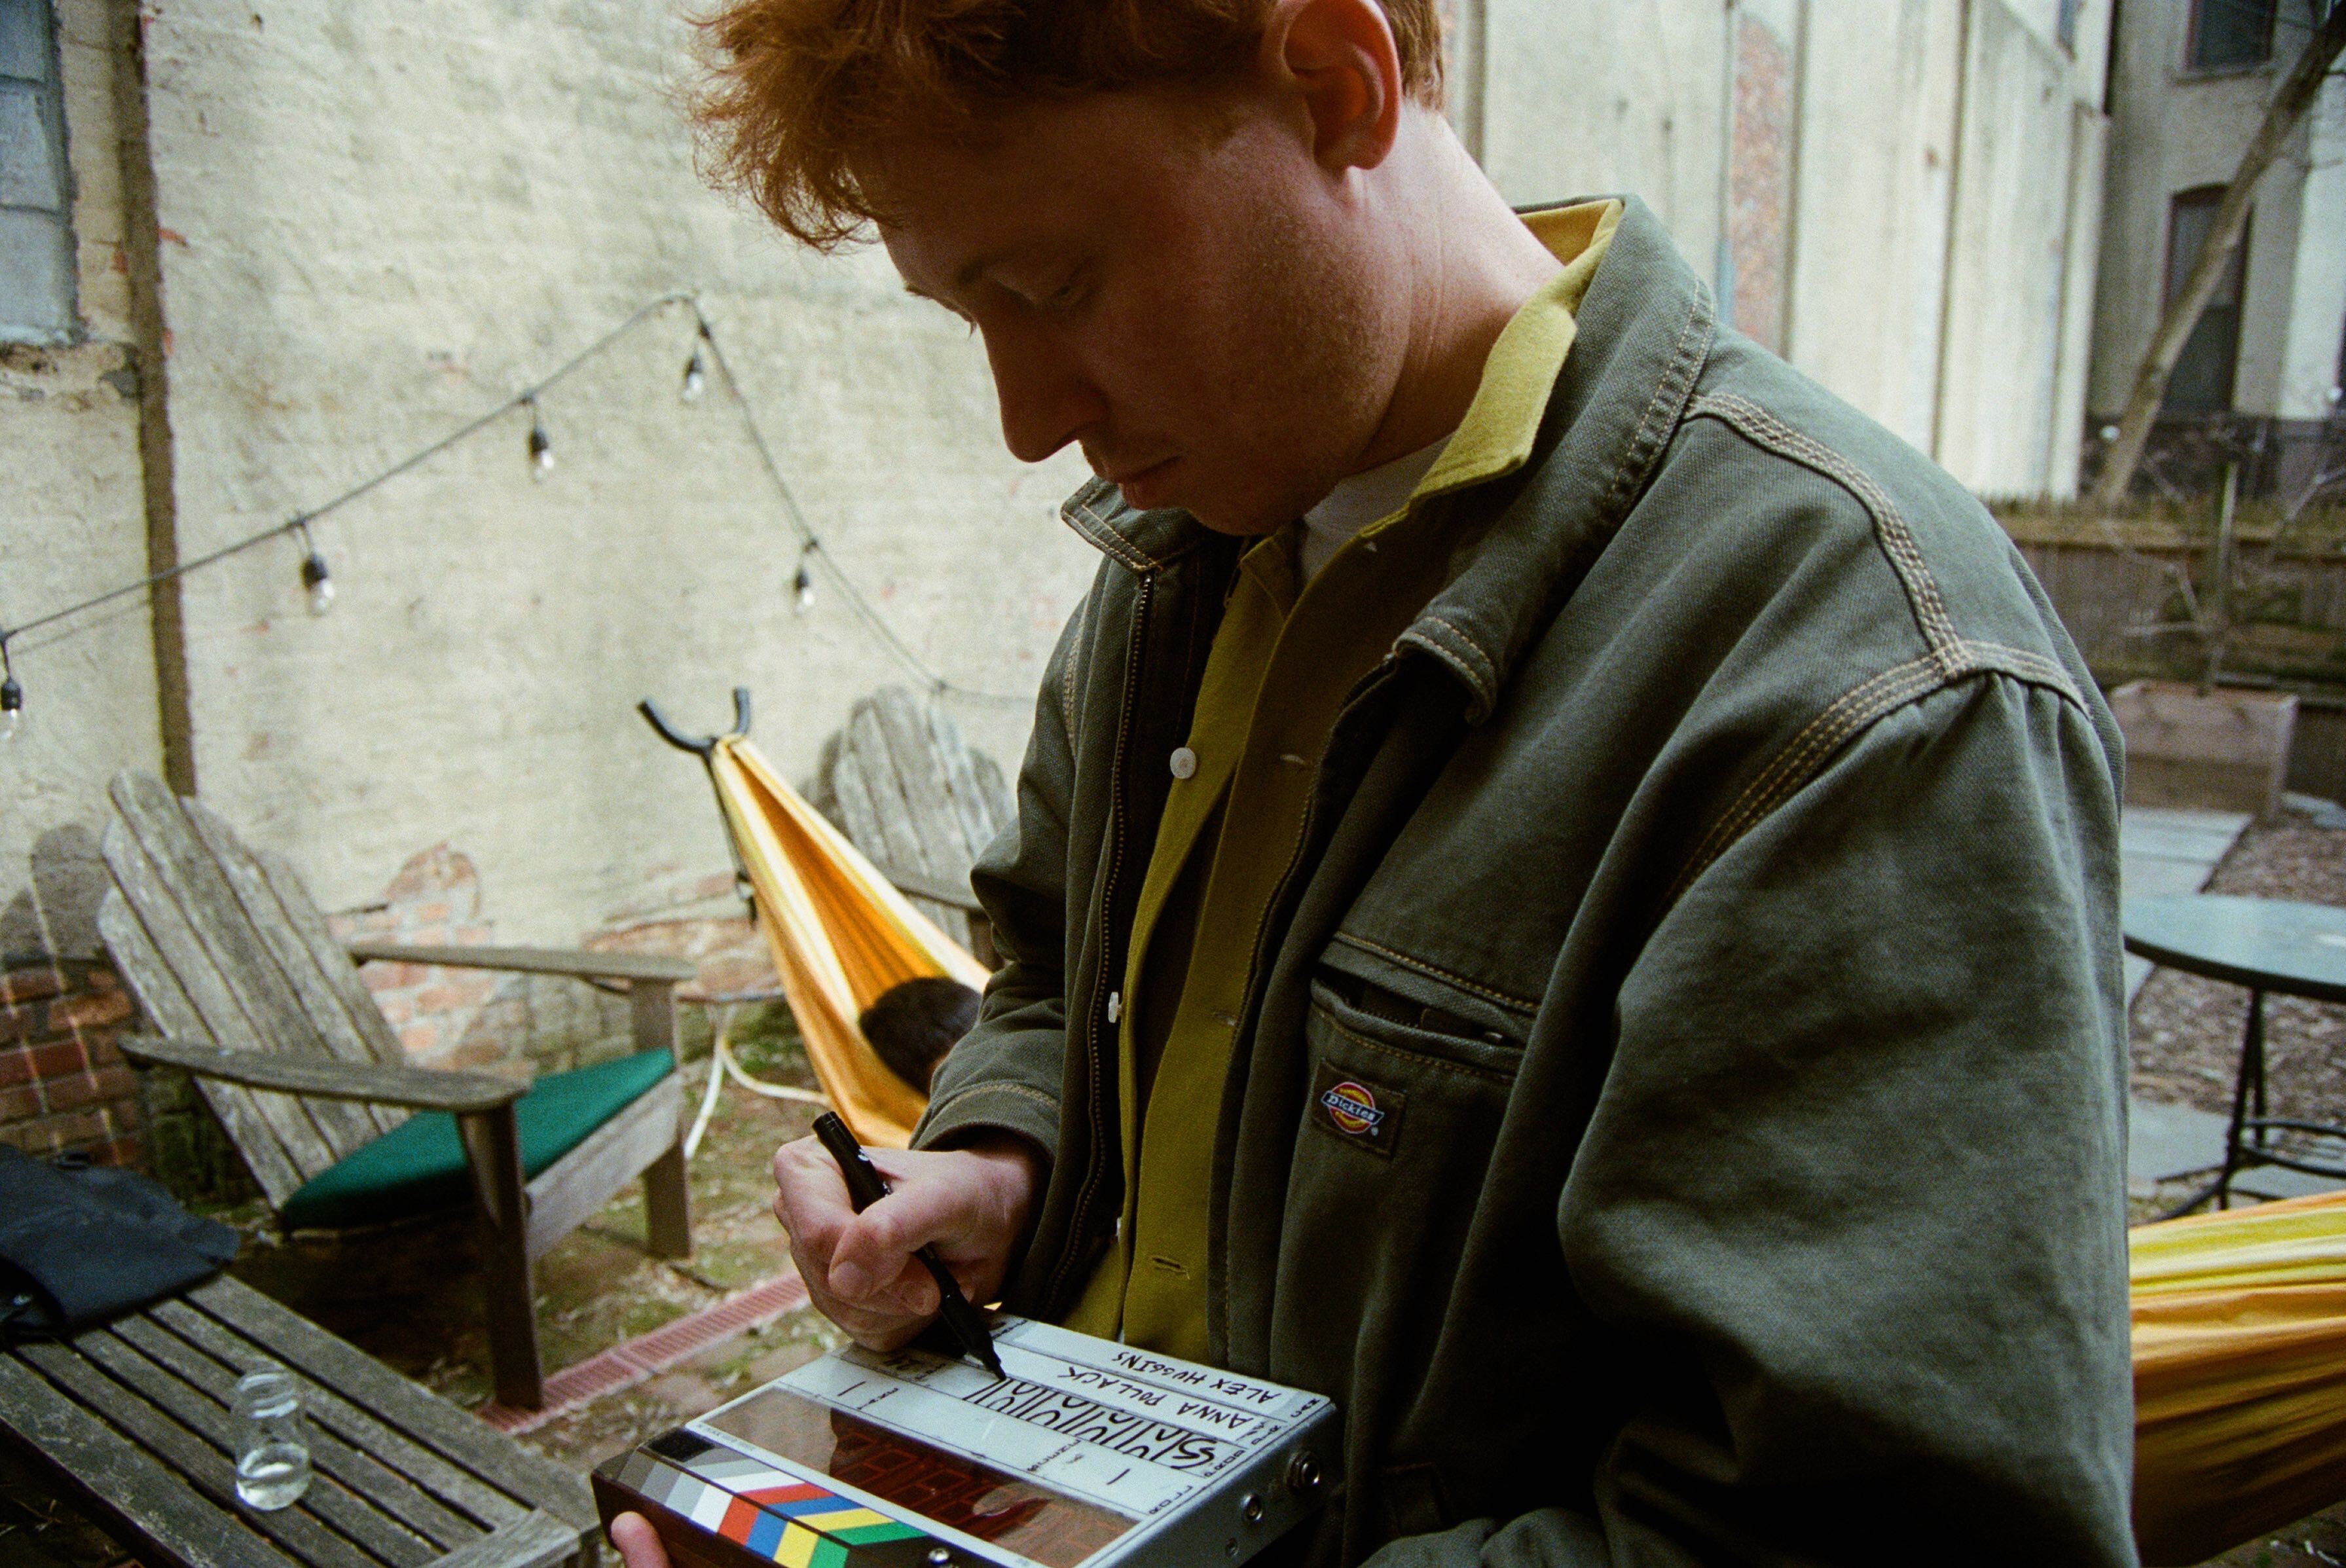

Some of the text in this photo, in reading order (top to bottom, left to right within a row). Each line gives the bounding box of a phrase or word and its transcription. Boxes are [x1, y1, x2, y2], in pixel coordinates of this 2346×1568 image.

[1327, 1094, 1375, 1121] Dickies
[1112, 1351, 1281, 1404] ALEX HUGGINS
[1058, 1366, 1254, 1429] ANNA POLLACK
[1251, 1425, 1281, 1445] DIR
[1205, 1449, 1245, 1477] PROD
[1149, 1486, 1194, 1515] ROLL
